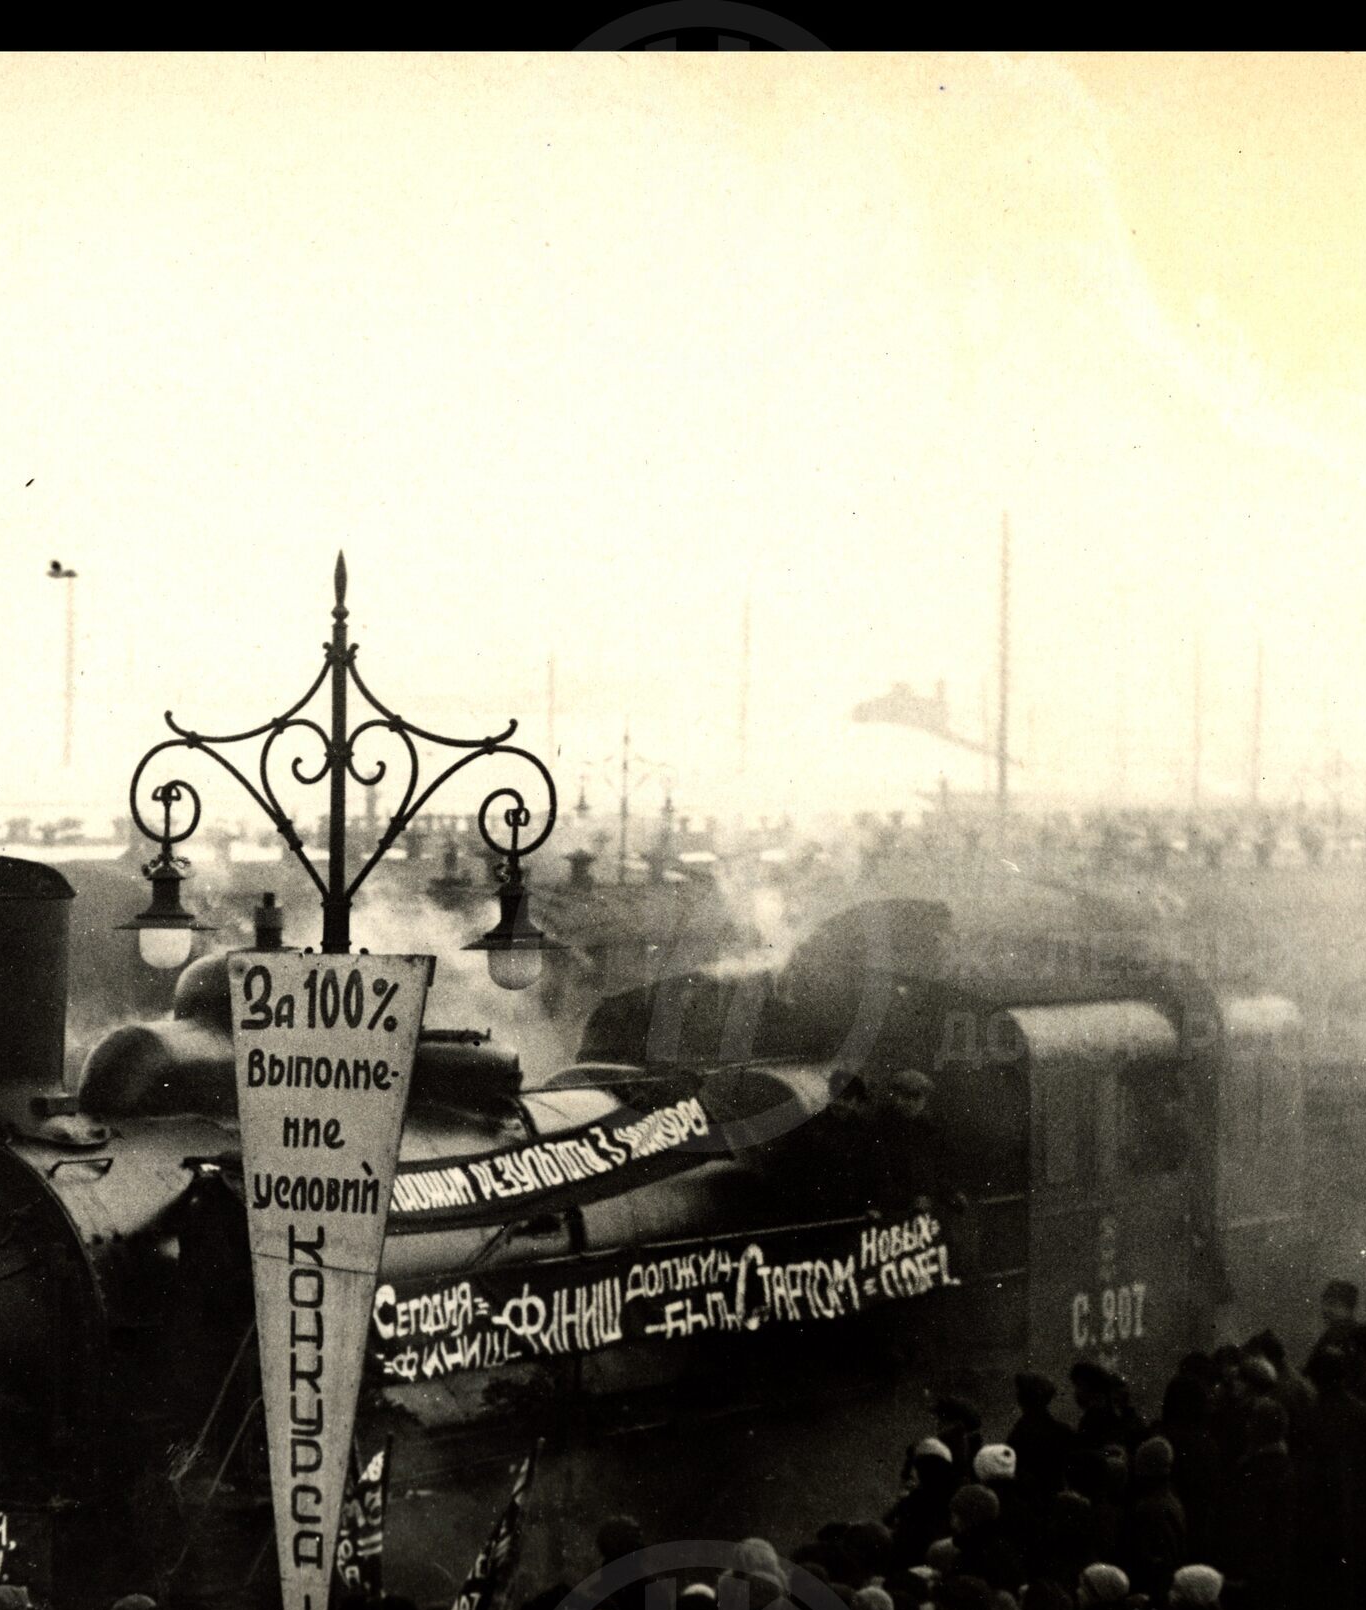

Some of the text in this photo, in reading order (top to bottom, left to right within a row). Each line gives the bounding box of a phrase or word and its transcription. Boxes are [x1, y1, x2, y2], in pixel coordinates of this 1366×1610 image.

[241, 965, 400, 1032] За 100%
[282, 1116, 346, 1150] ние
[252, 1160, 380, 1215] условий
